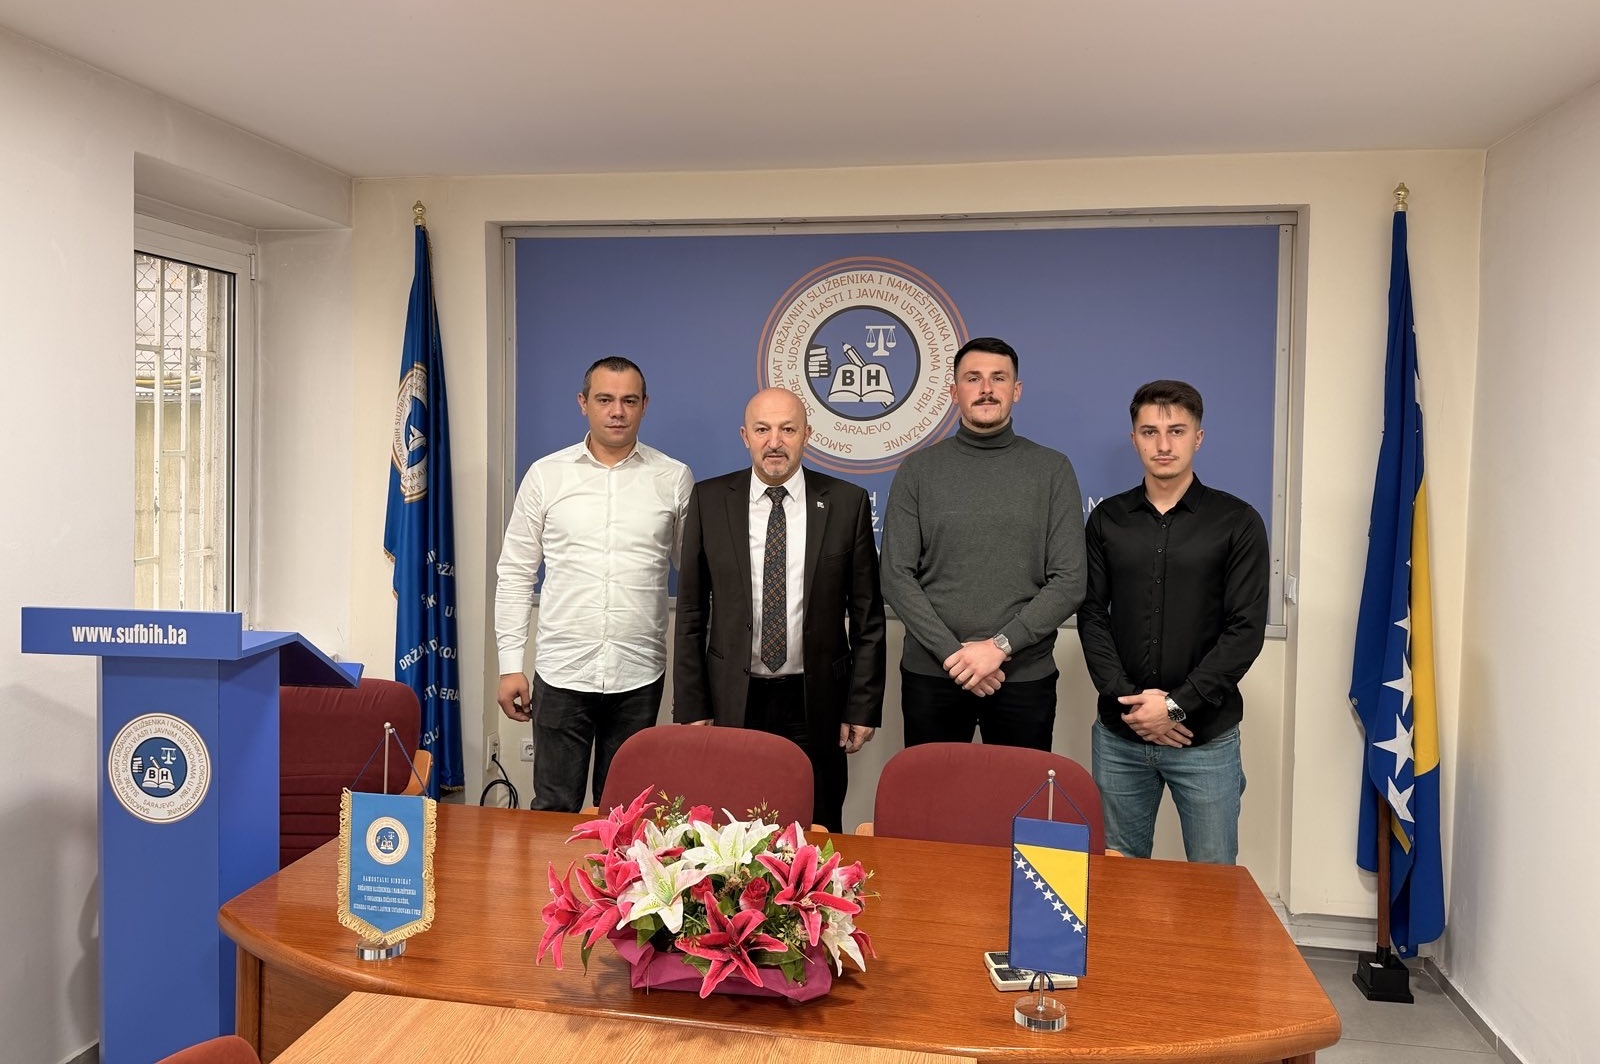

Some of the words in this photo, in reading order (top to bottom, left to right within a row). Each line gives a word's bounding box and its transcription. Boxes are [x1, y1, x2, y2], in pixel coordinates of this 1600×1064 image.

[807, 274, 874, 302] SLUŽBENIKA
[878, 275, 883, 285] I
[848, 289, 853, 299] I
[856, 288, 899, 304] JAVNIM
[807, 292, 844, 320] VLASTI
[887, 277, 951, 341] NAMJEŠTENIKA
[775, 300, 807, 354] DRŽAVNIH
[900, 300, 940, 372] USTANOVAMA
[788, 320, 810, 370] SUDSKOJ
[944, 344, 954, 352] U
[773, 358, 785, 389] DIKAT
[842, 370, 855, 386] B
[866, 369, 880, 386] H
[929, 376, 939, 384] U
[914, 387, 935, 413] FBIH
[833, 421, 891, 435] SARAJEVO
[884, 417, 932, 451] DRŽAVNE
[72, 624, 187, 644] www.sufbih.ba
[149, 770, 156, 778] B
[161, 771, 168, 780] H
[143, 800, 174, 809] SARAJEVO
